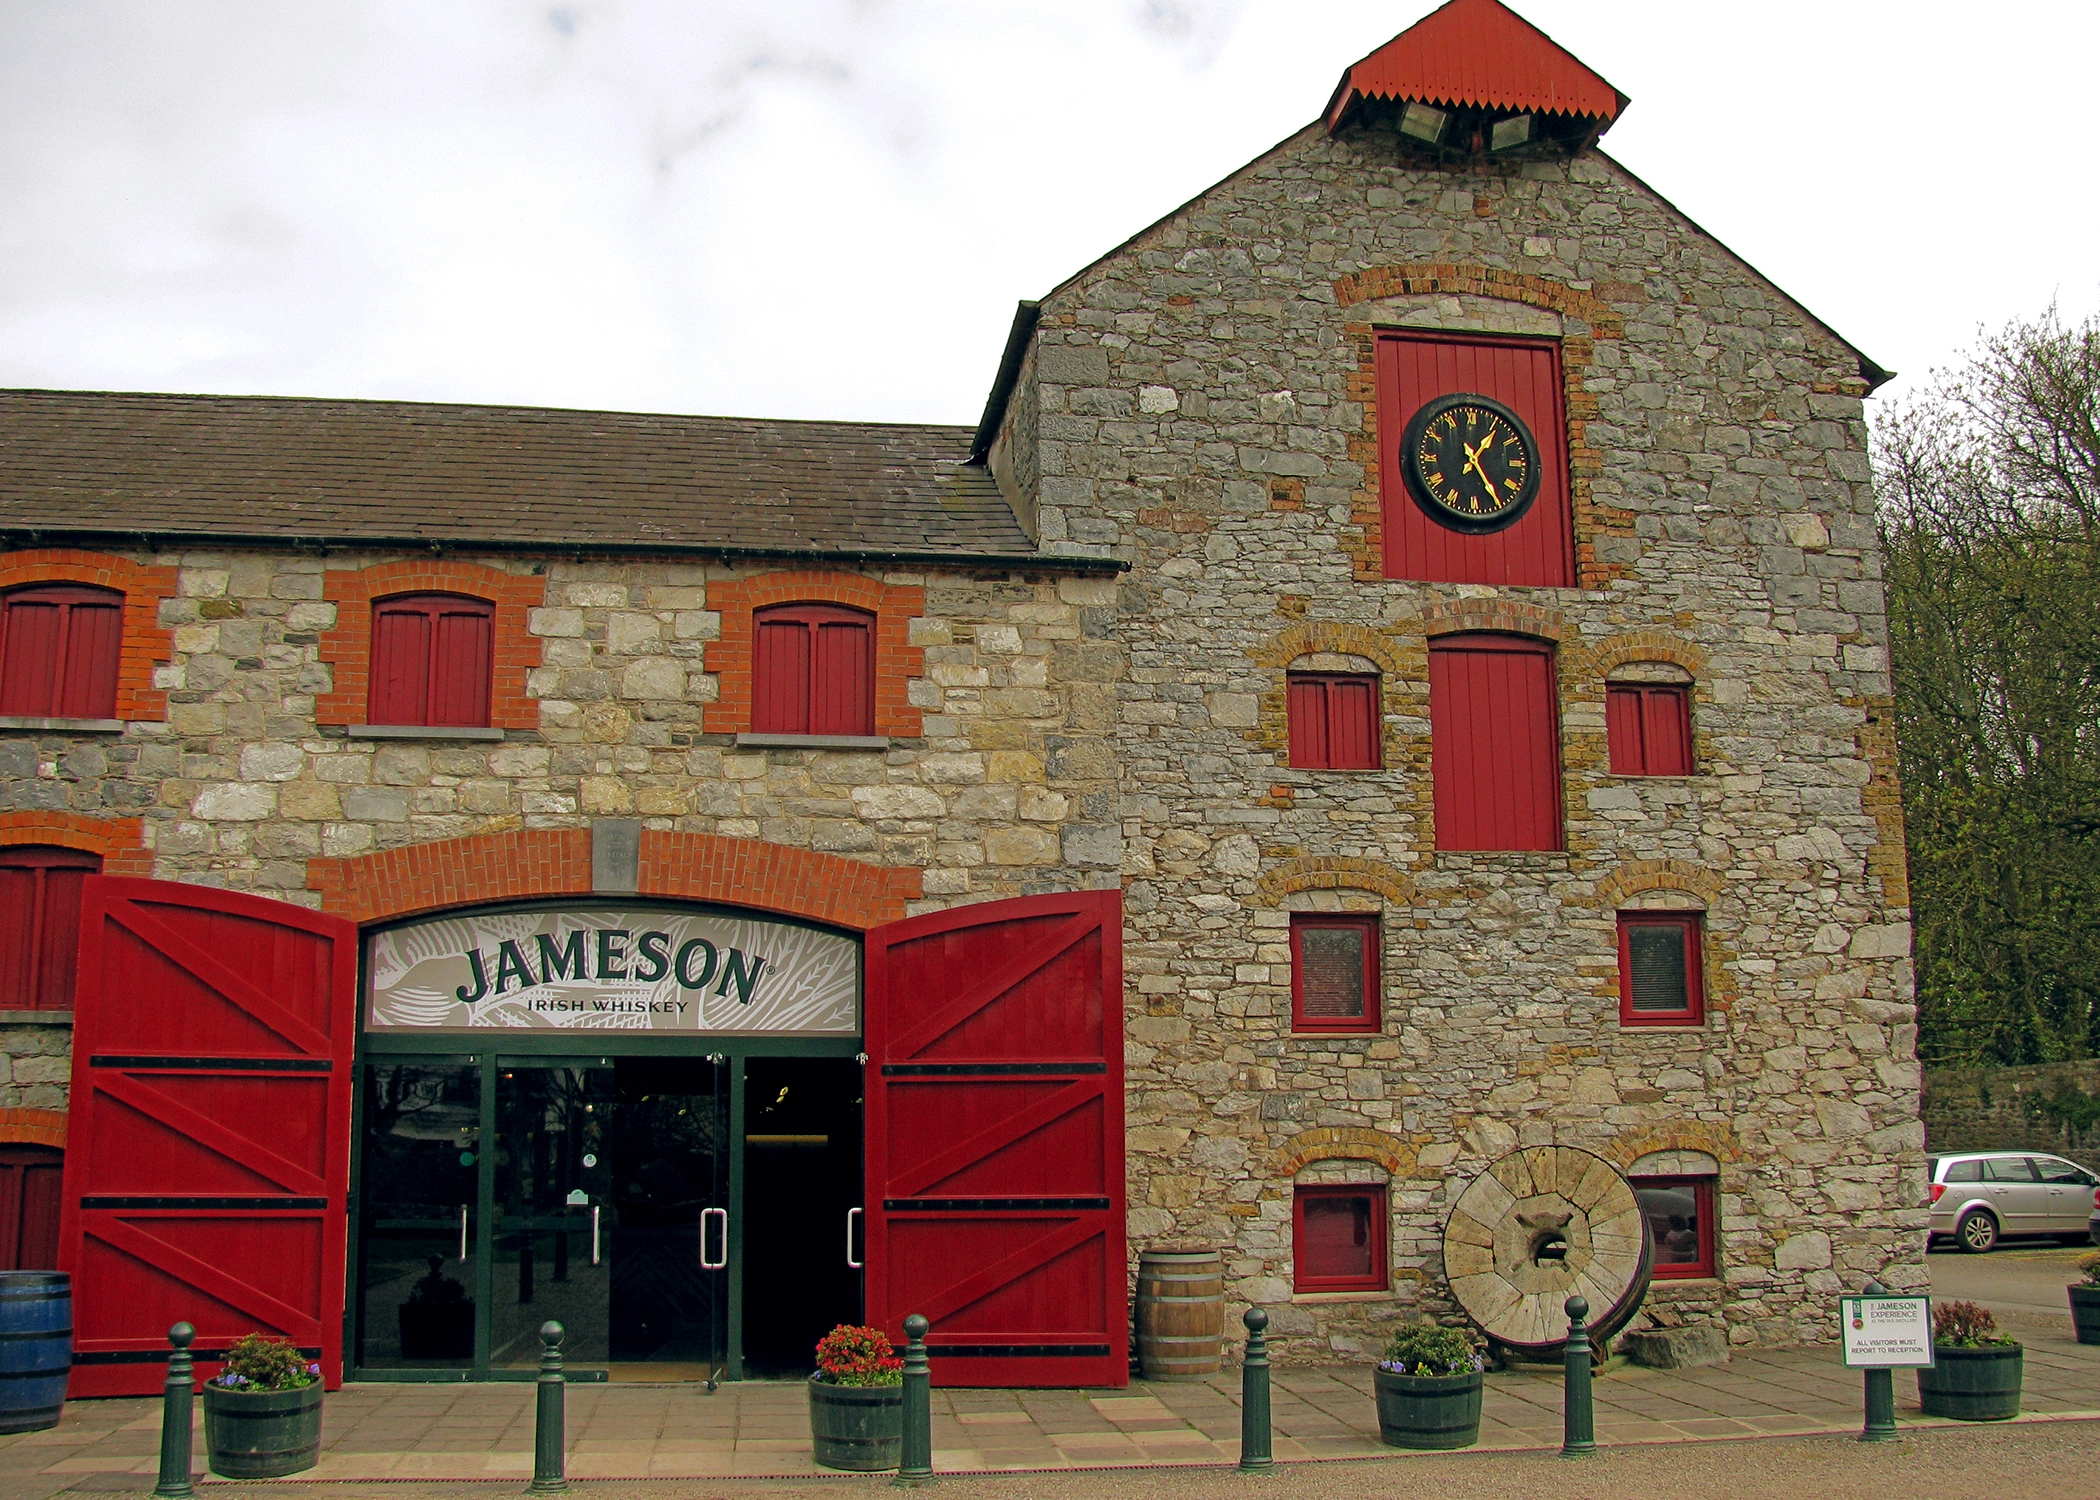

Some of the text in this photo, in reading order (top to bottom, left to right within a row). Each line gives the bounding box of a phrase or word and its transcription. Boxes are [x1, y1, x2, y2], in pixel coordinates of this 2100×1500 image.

[456, 929, 767, 1006] JAMESON
[527, 999, 689, 1014] IRISH WHISKEY
[1877, 1302, 1917, 1310] JAMESON
[1856, 1339, 1869, 1347] ALL
[1887, 1346, 1924, 1354] RECEPTION
